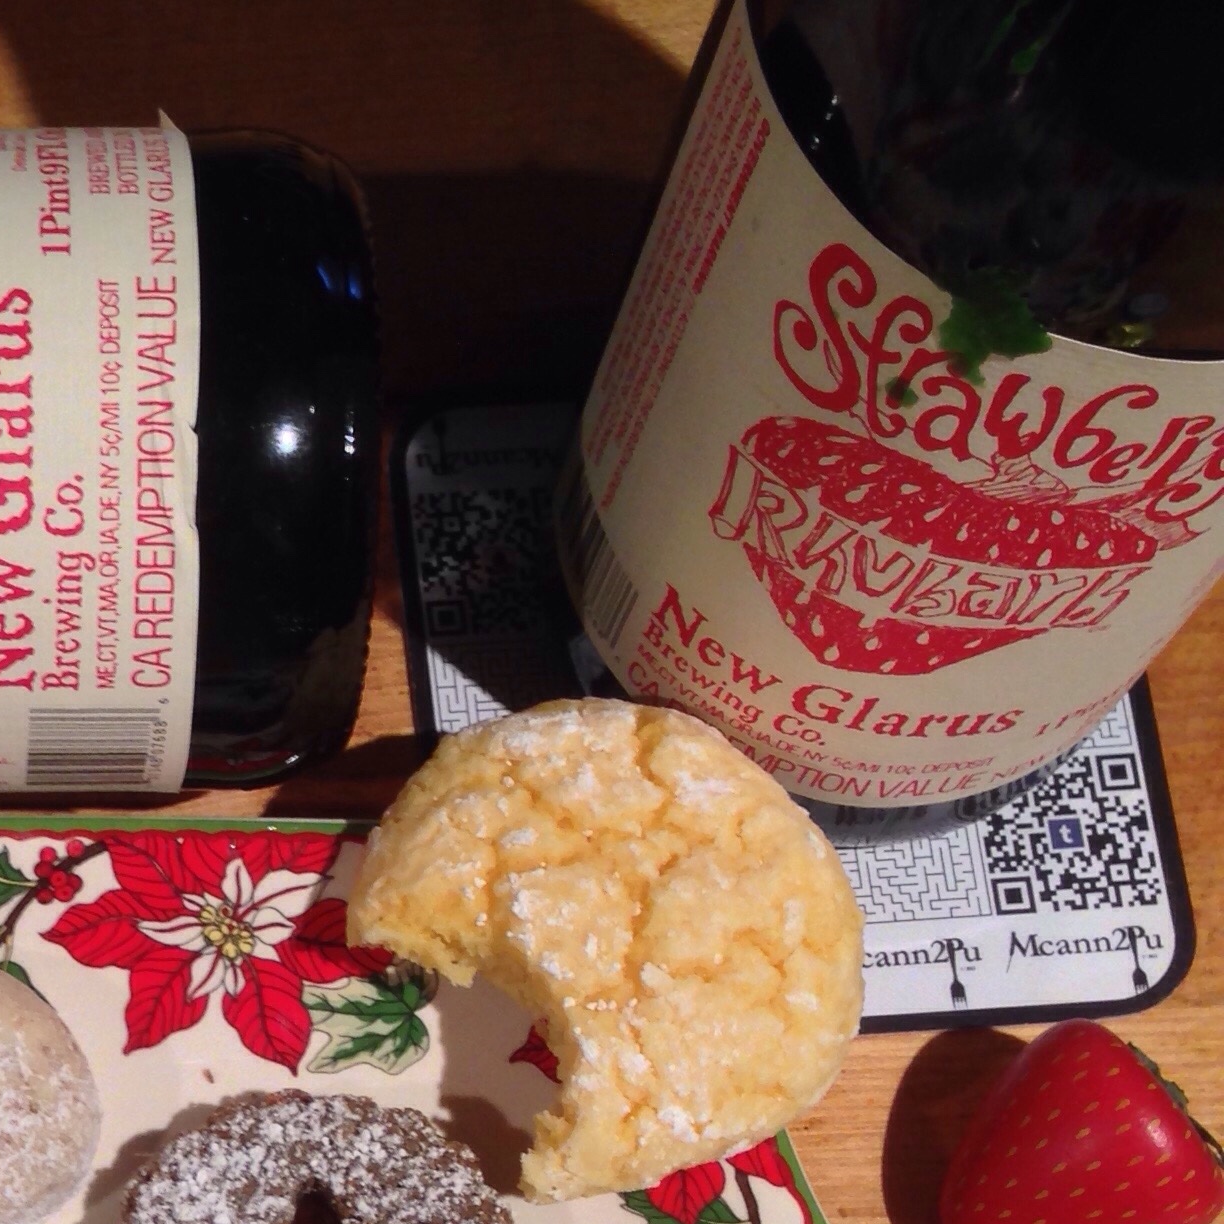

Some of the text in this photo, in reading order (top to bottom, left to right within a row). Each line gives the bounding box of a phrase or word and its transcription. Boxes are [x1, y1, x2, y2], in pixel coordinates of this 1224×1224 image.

[40, 243, 72, 256] 1
[149, 207, 177, 264] NEW
[98, 278, 121, 356] DEPOSIT
[131, 275, 177, 689] CA REDEMPTION VALUE
[41, 474, 96, 692] Brewing Co.
[642, 617, 827, 748] Brewing Co.
[651, 581, 783, 695] New
[791, 683, 1025, 738] Glarus
[878, 771, 985, 799] VALUE
[1005, 925, 1164, 975] Mcann2Pu
